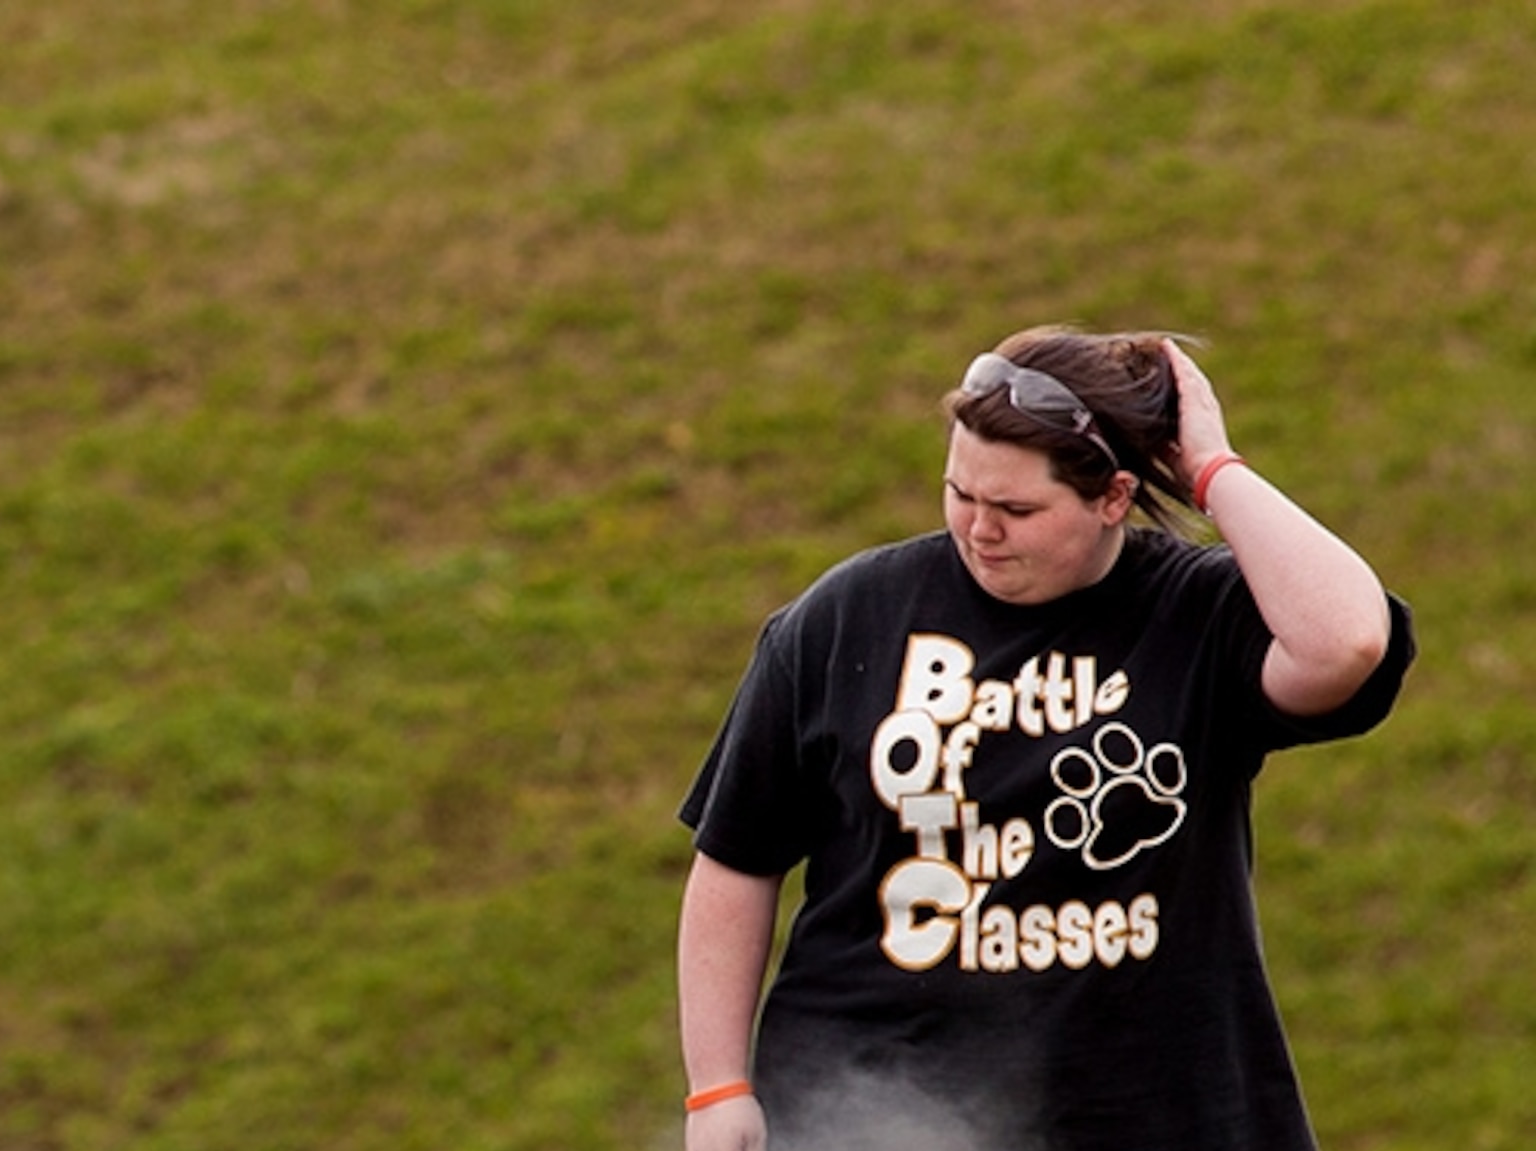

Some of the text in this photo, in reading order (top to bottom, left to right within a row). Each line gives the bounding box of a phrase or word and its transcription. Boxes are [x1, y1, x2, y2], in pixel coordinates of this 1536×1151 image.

[895, 631, 1131, 738] Battle
[869, 707, 982, 812] Of
[897, 790, 1036, 881] The
[877, 855, 1160, 973] Classes
